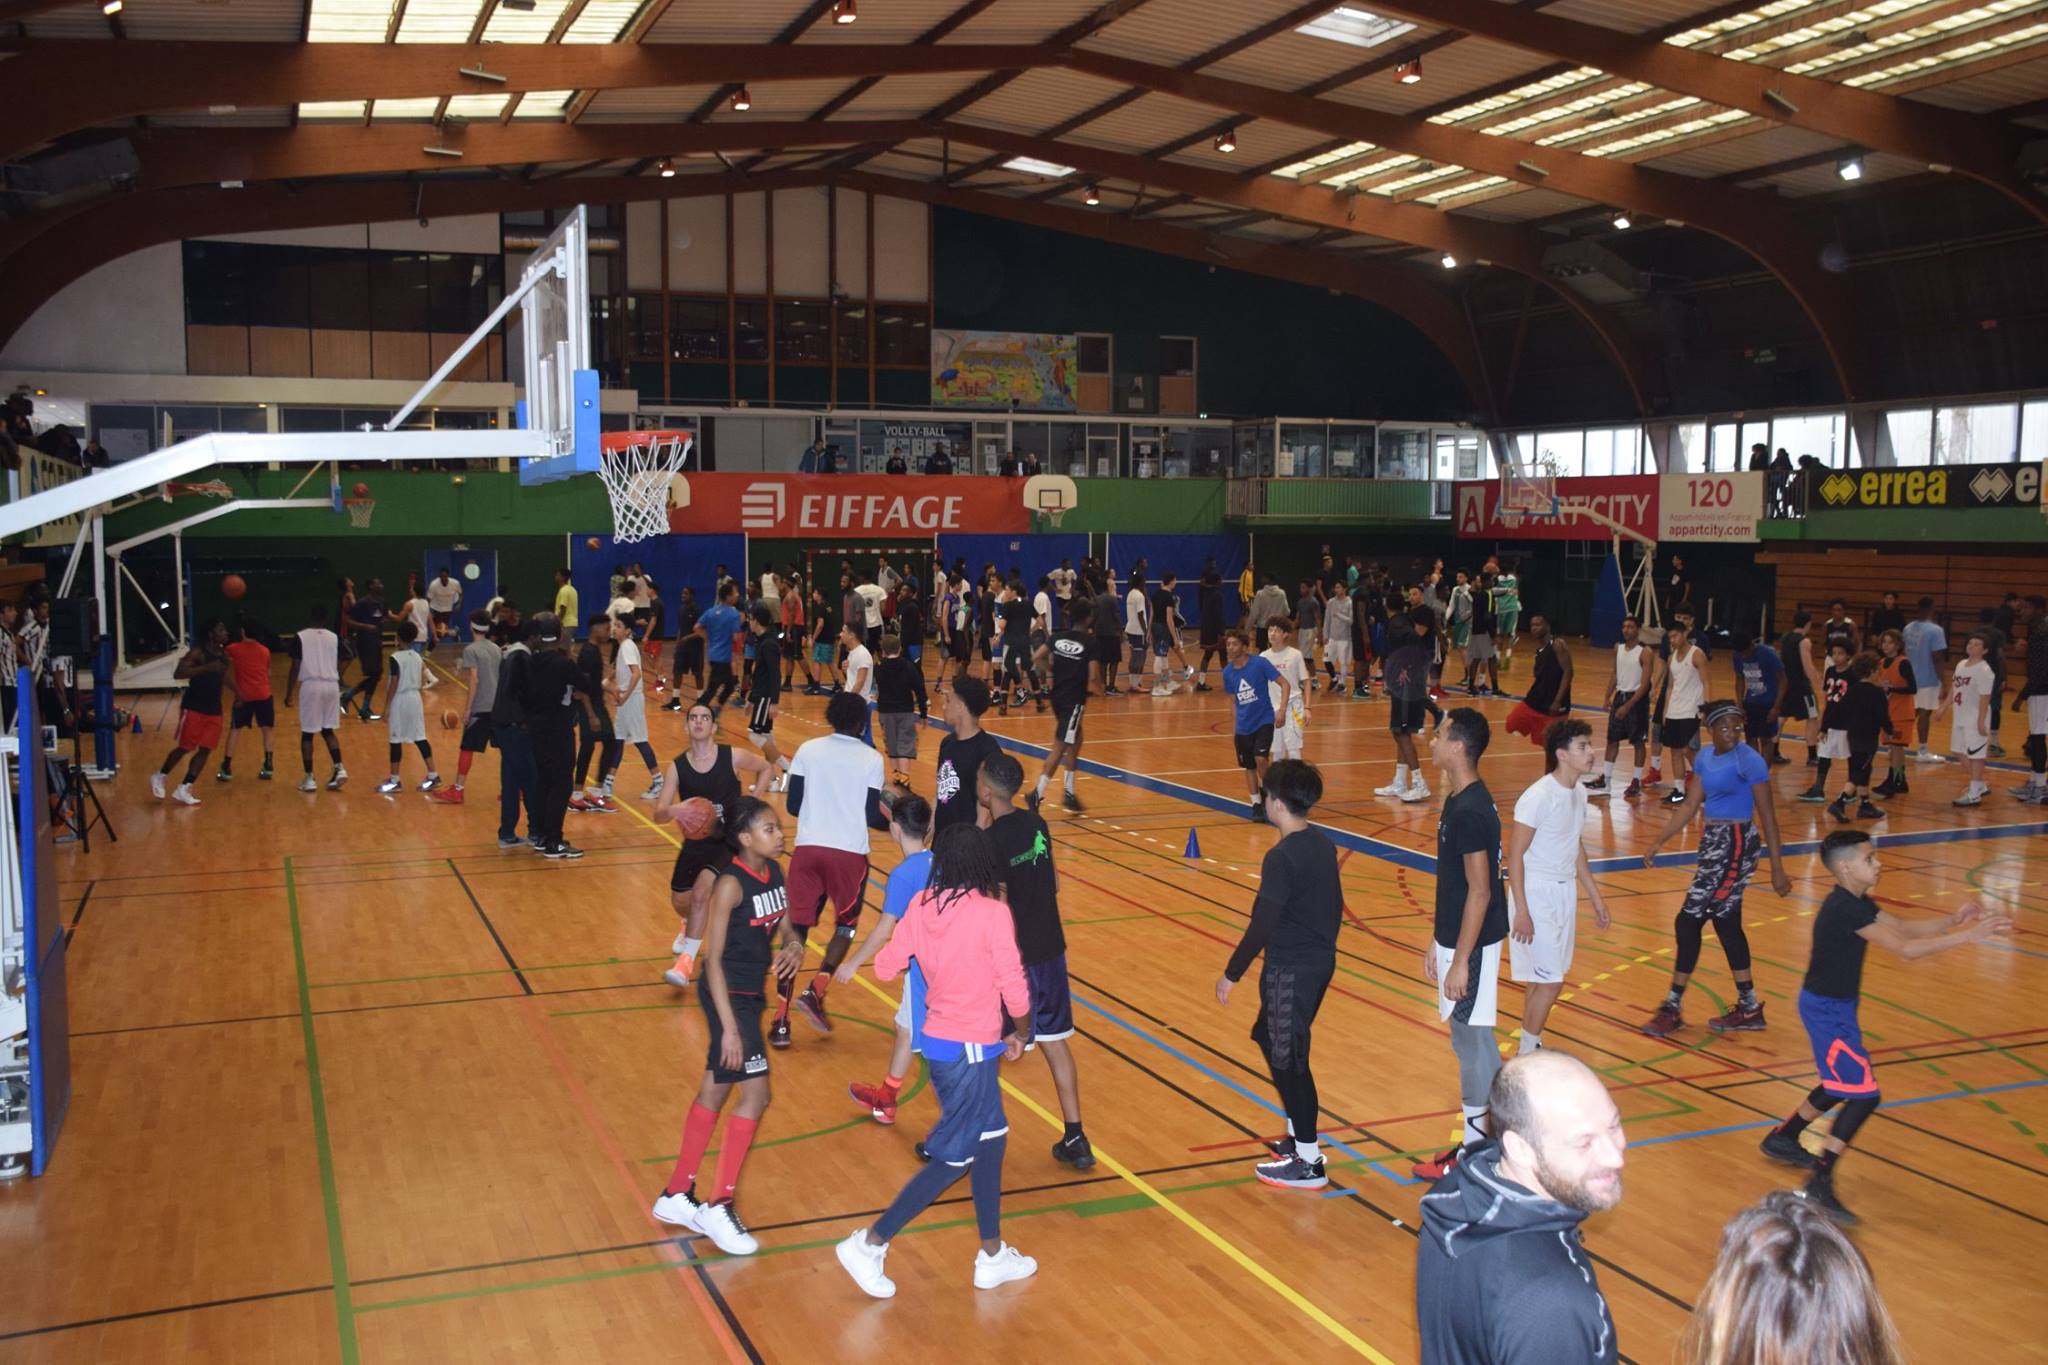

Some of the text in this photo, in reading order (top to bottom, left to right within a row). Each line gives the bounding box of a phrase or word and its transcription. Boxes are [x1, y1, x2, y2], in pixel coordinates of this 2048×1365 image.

[884, 425, 946, 437] VOLLEY-BALL
[1688, 479, 1733, 507] 120
[1859, 470, 1947, 506] errea
[800, 495, 963, 528] EIFFAGE
[1669, 524, 1751, 537] appartcity.com
[1954, 692, 1962, 706] 4
[752, 885, 787, 918] BULLS
